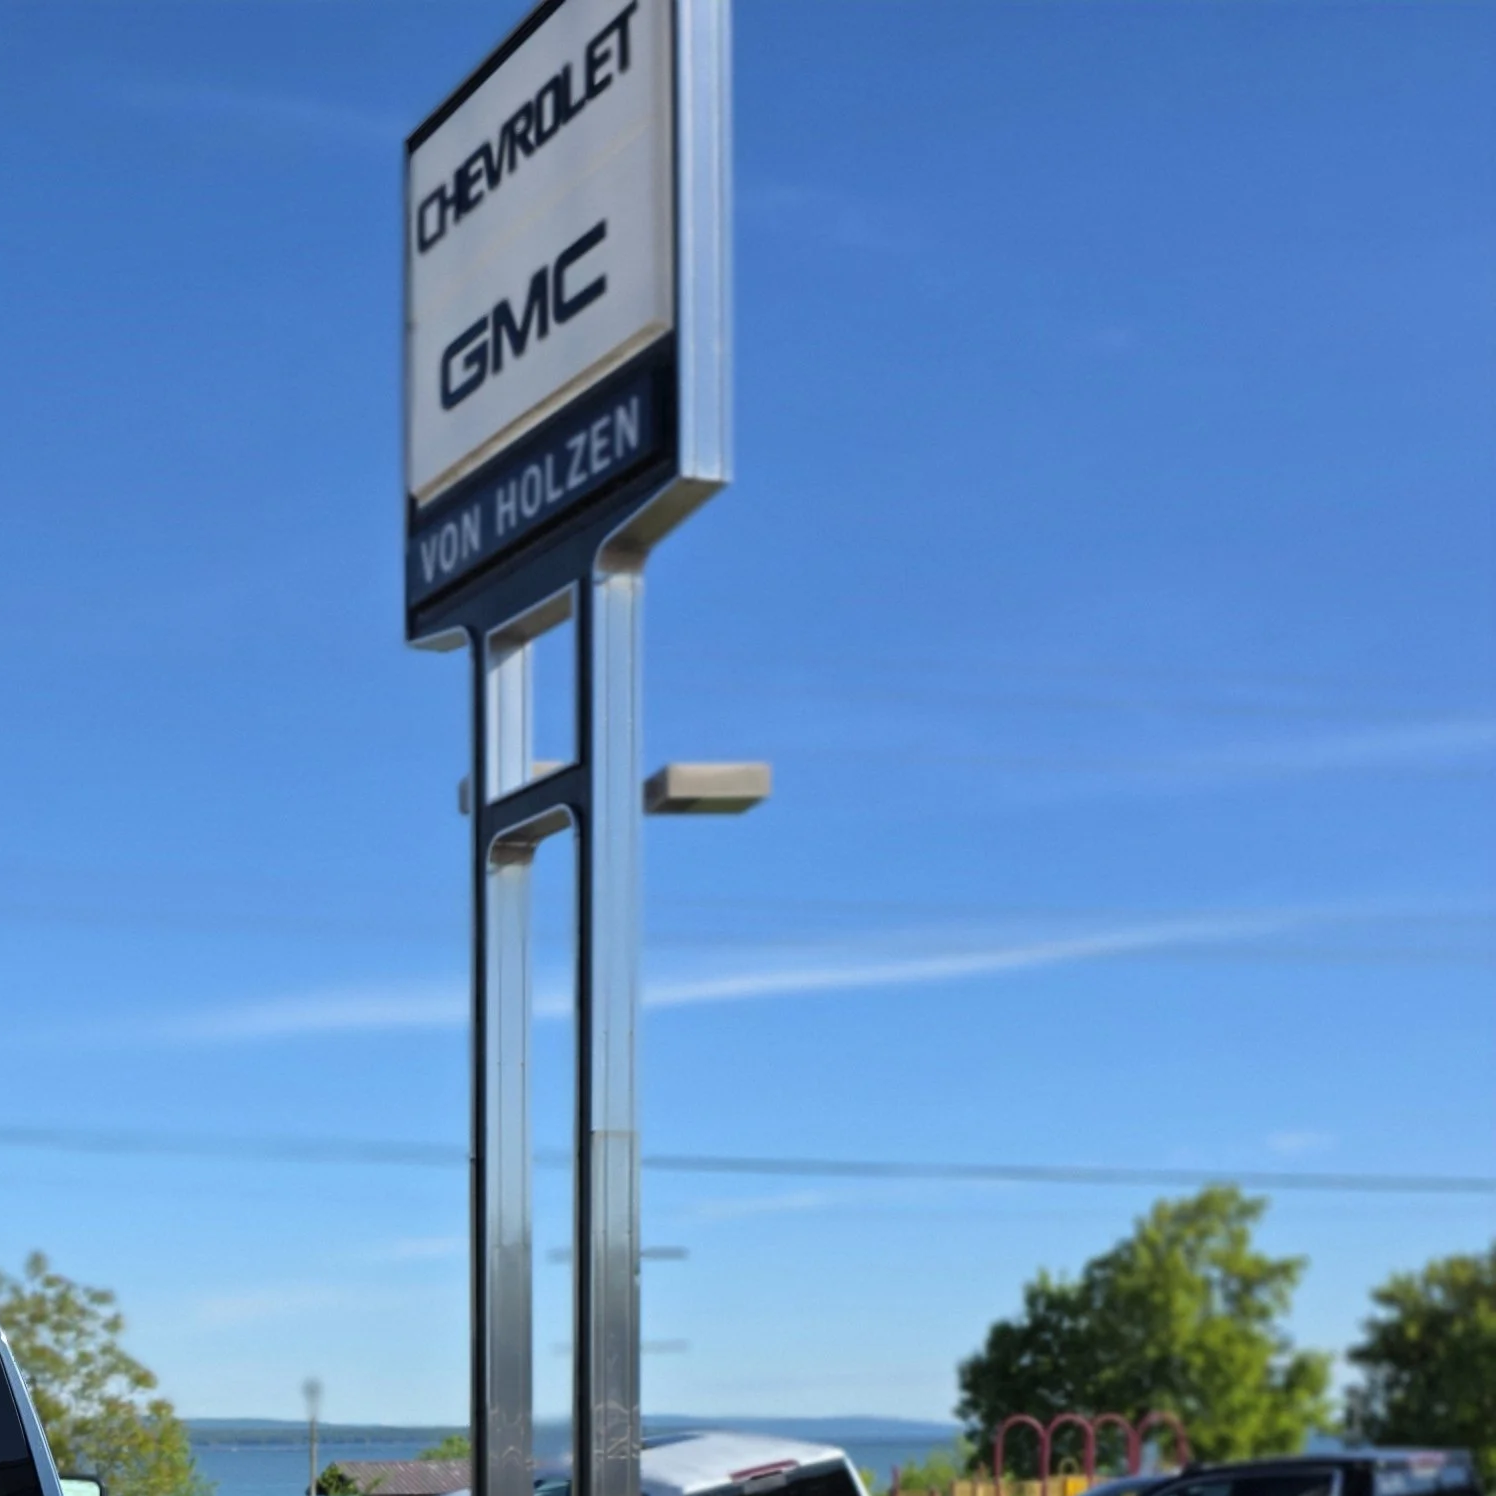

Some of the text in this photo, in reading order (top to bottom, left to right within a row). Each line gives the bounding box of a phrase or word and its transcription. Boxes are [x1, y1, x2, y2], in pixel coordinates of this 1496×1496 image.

[416, 1, 639, 255] CHEVROLET
[440, 218, 609, 412] GMC
[420, 396, 641, 584] VON HOLZEN
